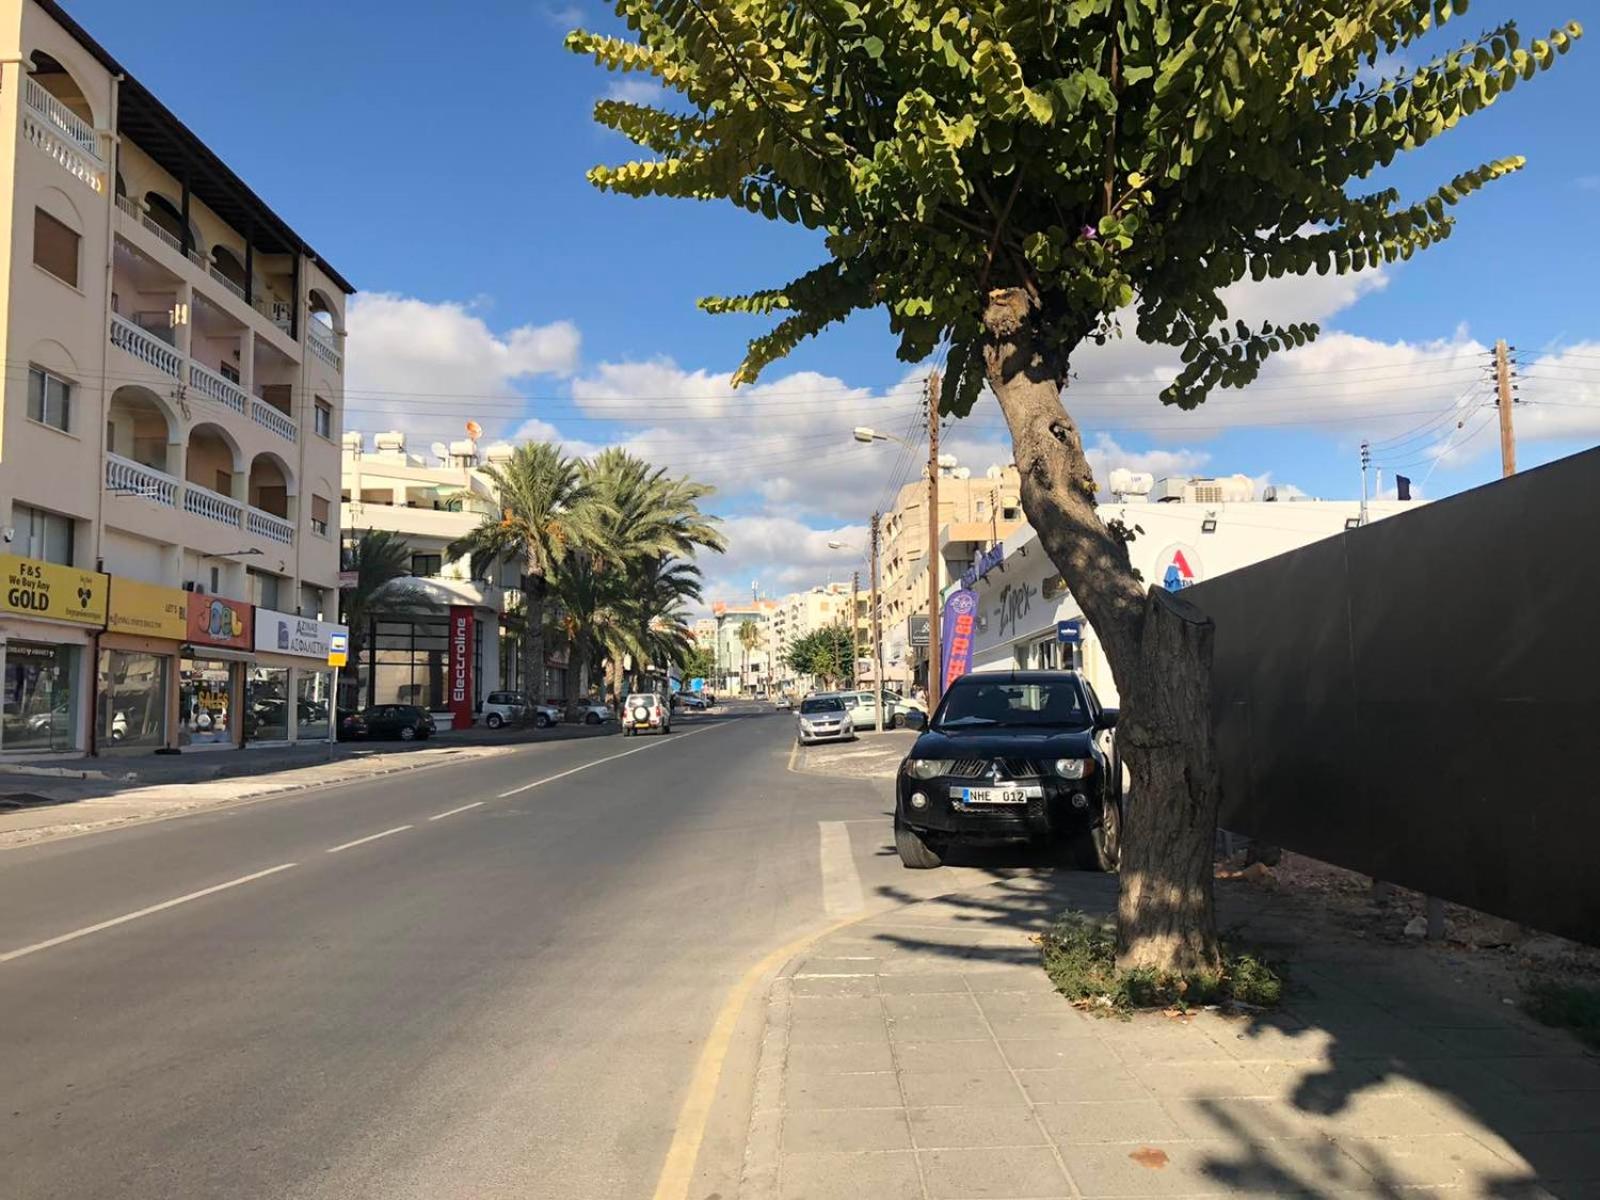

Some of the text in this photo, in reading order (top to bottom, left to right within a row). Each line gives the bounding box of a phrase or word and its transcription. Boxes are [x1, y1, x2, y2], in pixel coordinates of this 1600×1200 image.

[9, 575, 51, 593] We Buy Any
[8, 588, 50, 611] GOLD
[453, 618, 465, 701] Electroline
[198, 690, 229, 709] SALES
[970, 790, 1024, 802] NHE 012
